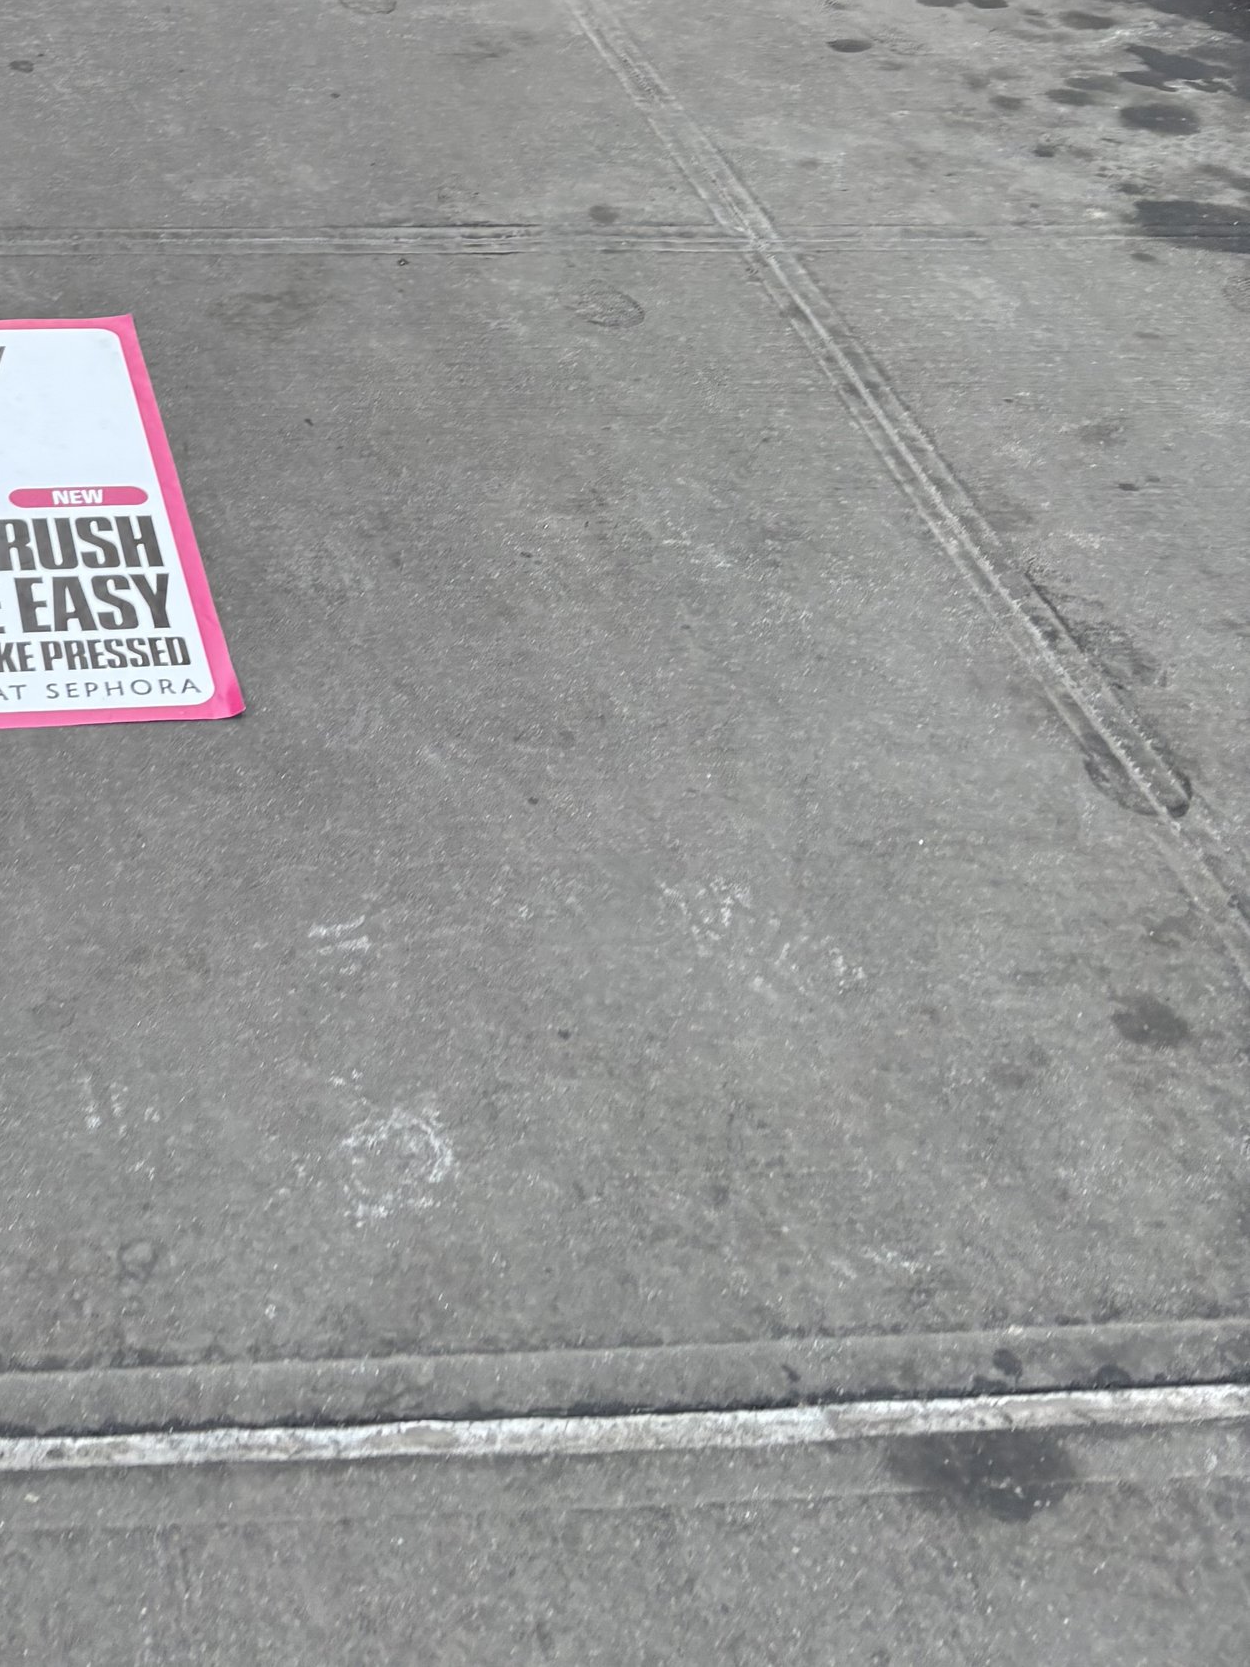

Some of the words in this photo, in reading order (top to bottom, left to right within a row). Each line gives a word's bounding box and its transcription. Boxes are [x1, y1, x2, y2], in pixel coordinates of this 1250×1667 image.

[52, 489, 104, 505] NEW
[14, 573, 171, 633] EASY
[41, 636, 191, 671] PRESSED
[46, 678, 202, 699] SEPHORA
